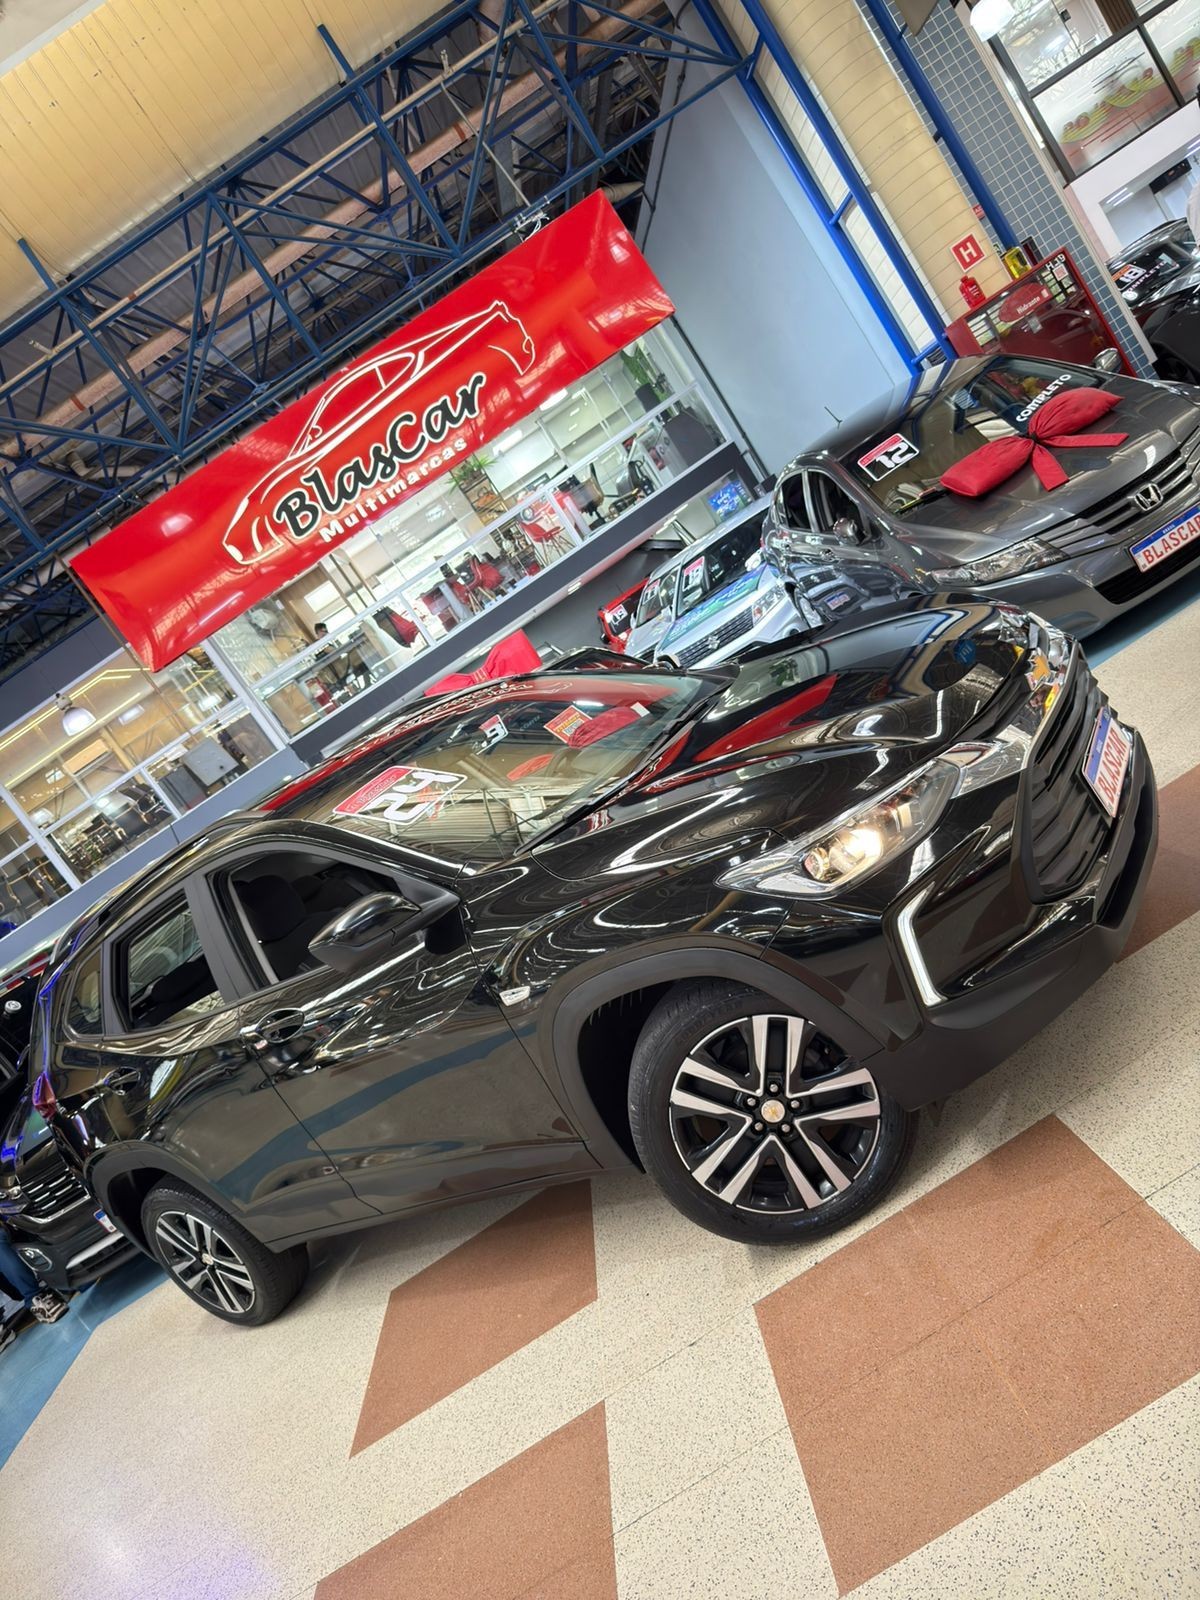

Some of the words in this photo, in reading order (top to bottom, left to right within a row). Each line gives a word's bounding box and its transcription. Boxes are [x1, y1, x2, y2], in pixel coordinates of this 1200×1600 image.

[959, 241, 978, 263] H
[1119, 267, 1144, 283] 18
[1016, 296, 1041, 315] Hidrante
[1015, 374, 1072, 422] COMPLETO
[273, 372, 486, 539] BlasCar
[875, 441, 914, 469] 12
[319, 437, 467, 543] Multimarcas
[1098, 727, 1127, 804] BLASCAR
[363, 771, 460, 820] 24
